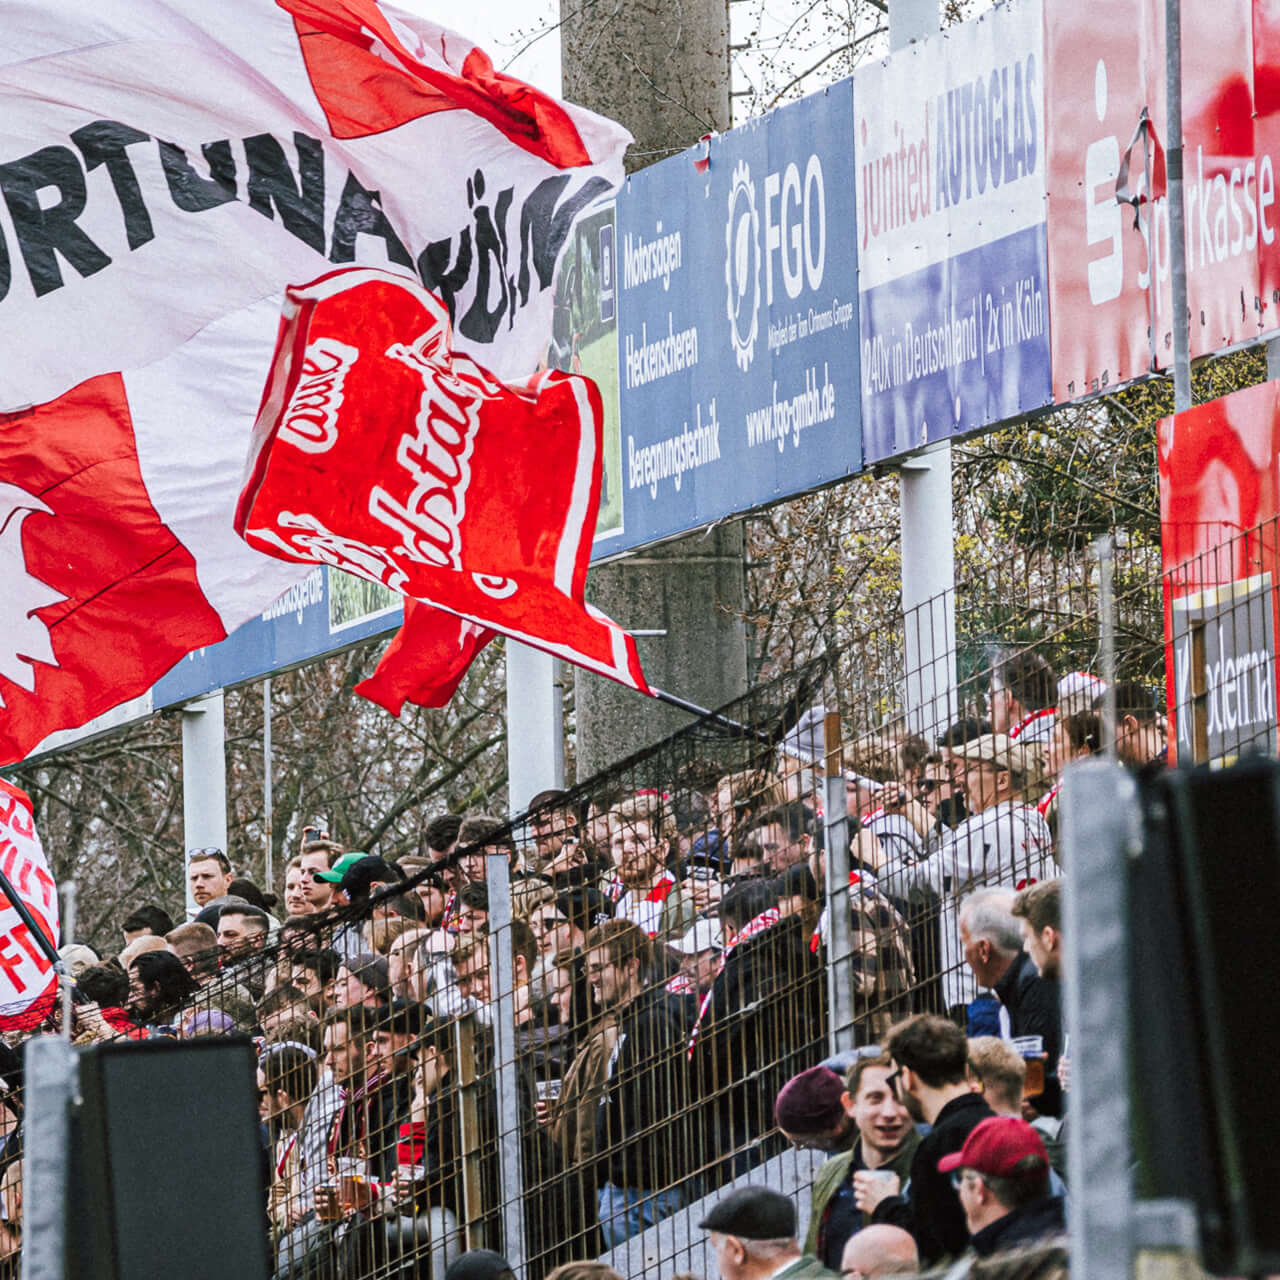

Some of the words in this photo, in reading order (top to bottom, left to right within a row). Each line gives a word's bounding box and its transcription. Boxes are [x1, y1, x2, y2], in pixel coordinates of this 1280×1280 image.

[862, 101, 931, 250] junited
[934, 53, 1038, 212] AUTOGLAS
[624, 220, 682, 291] Motorsägen
[764, 153, 826, 306] FGO
[626, 312, 698, 389] Heckenscheren
[864, 336, 891, 396] 240x
[905, 303, 978, 383] Deutschland
[1016, 274, 1046, 341] Köln
[628, 397, 721, 500] Beregnungstechnik
[746, 361, 835, 453] www.fgo-gmbh.de
